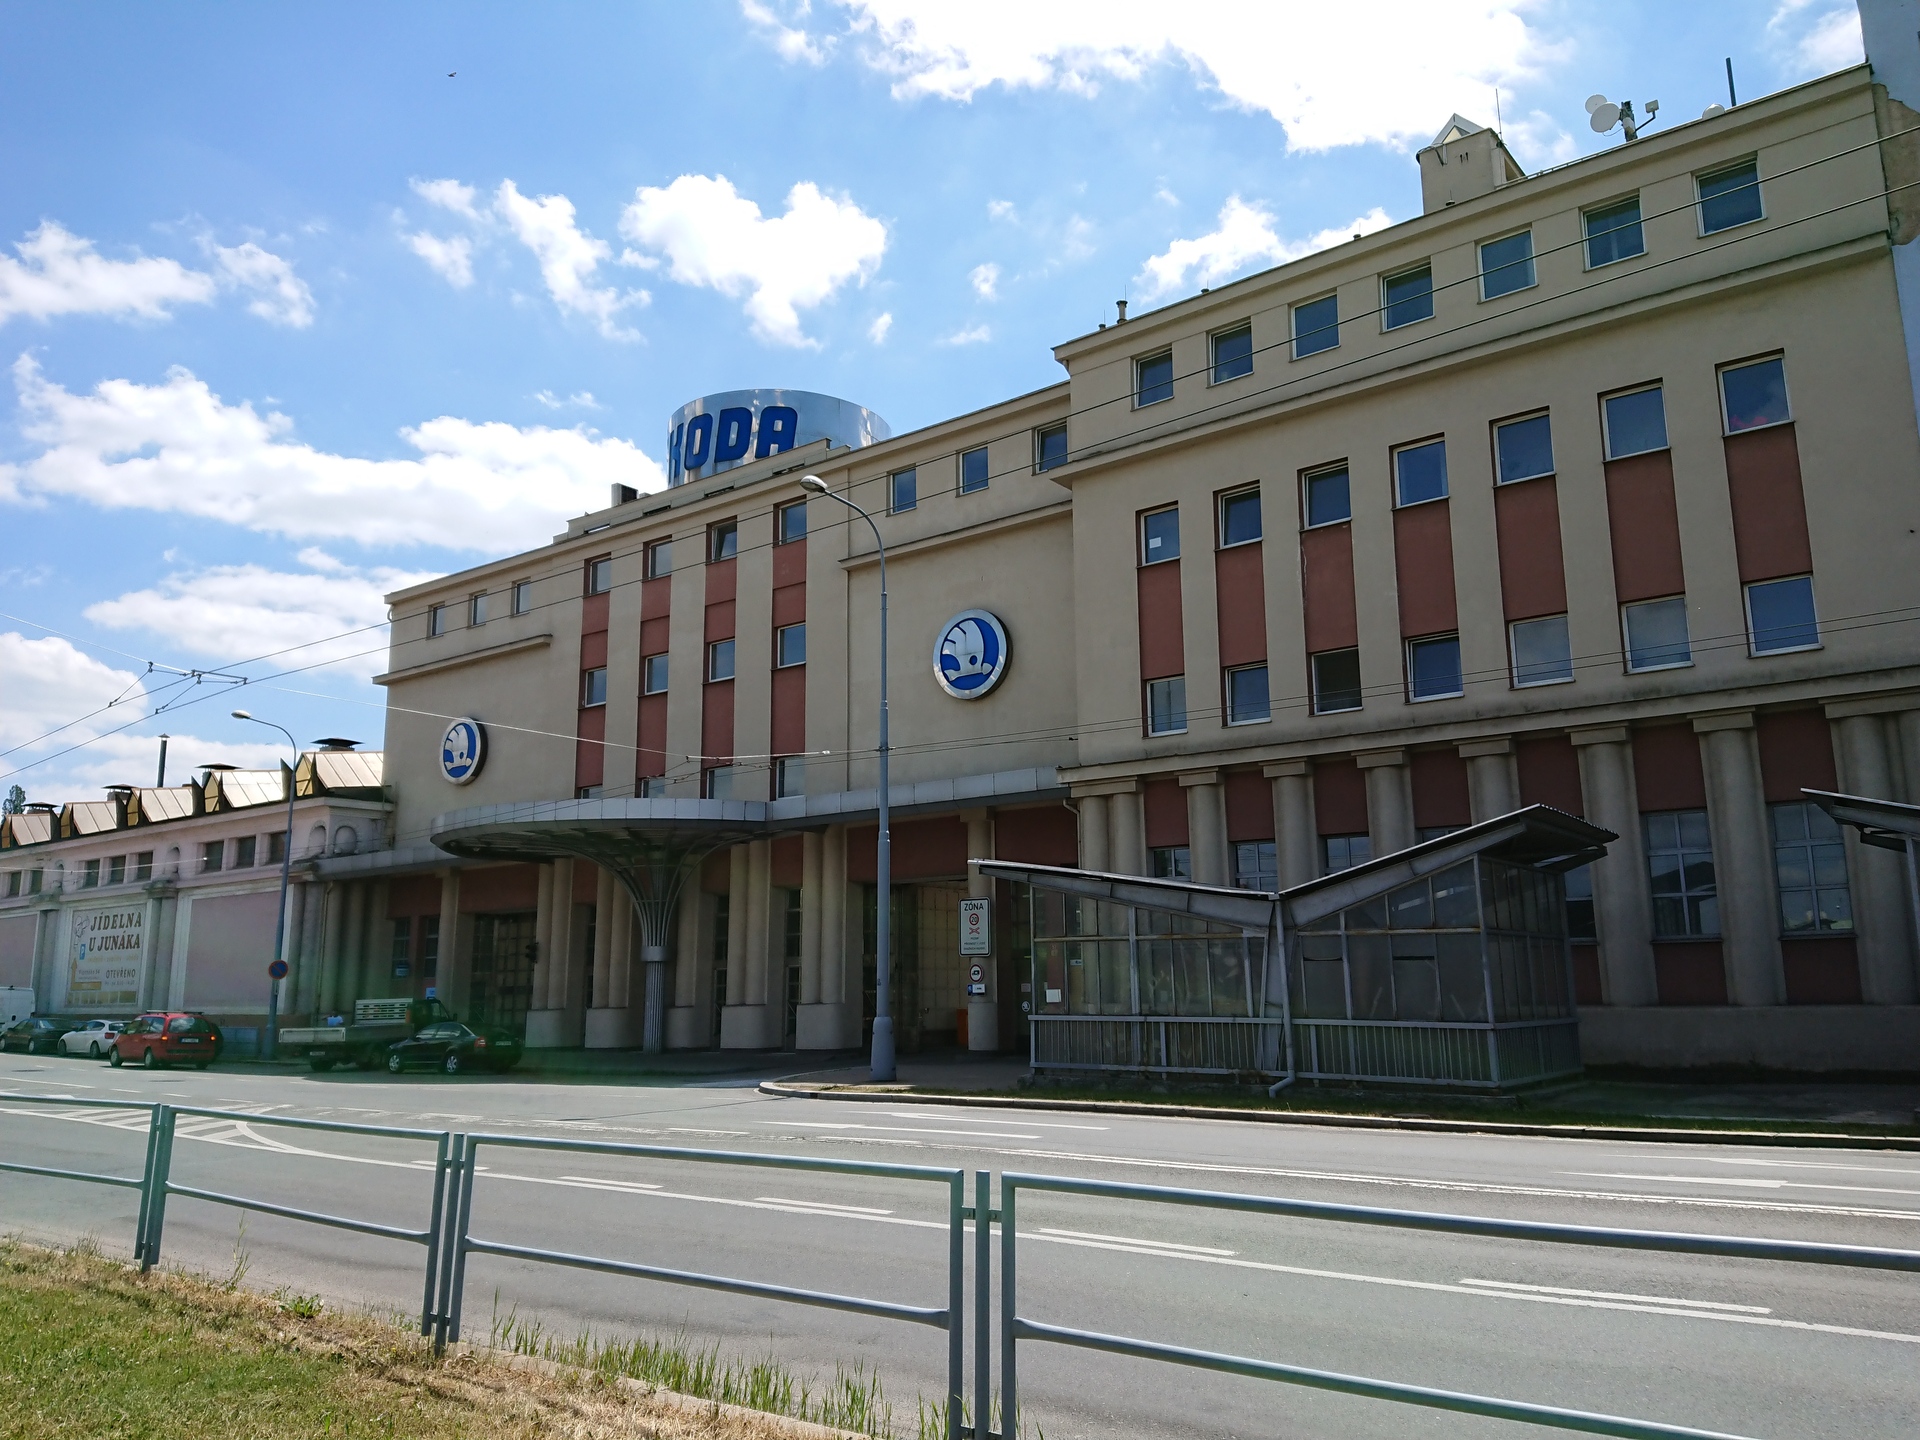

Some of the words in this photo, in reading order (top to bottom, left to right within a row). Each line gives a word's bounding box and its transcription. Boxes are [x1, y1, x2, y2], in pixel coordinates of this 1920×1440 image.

[667, 406, 798, 483] KODA
[964, 901, 984, 911] ZÓNA
[90, 912, 142, 931] JÍDELNA
[89, 937, 96, 952] U
[98, 931, 140, 951] JUNÁKA
[105, 967, 135, 979] OTEVŘENO
